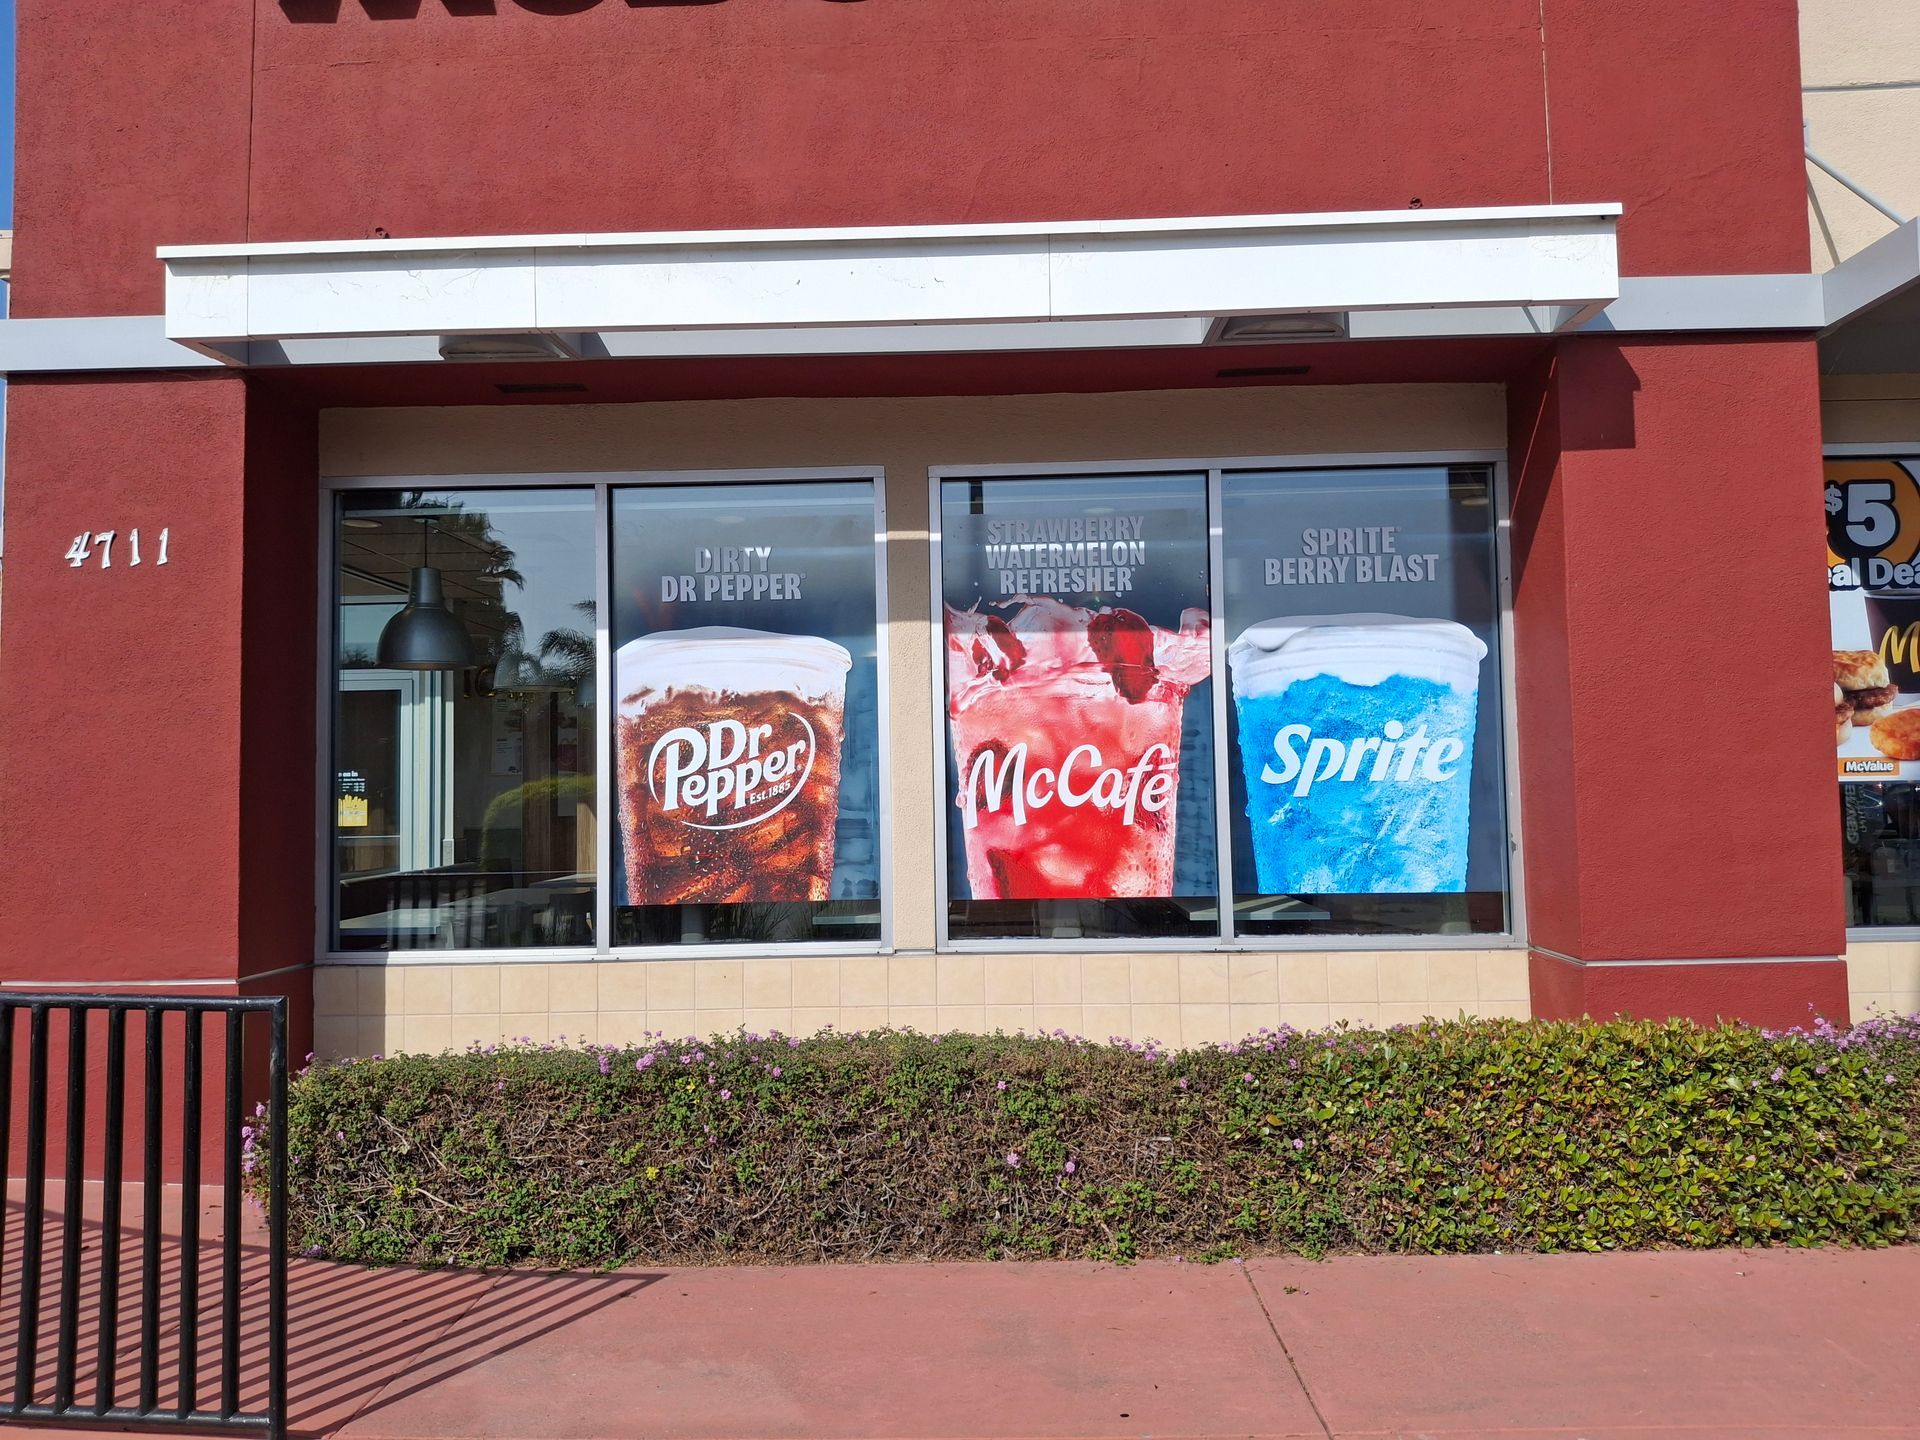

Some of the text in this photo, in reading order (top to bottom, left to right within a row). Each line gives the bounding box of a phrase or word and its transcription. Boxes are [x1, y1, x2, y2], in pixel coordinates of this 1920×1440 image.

[986, 516, 1145, 545] STRAWBERRY
[1824, 484, 1896, 547] $5
[65, 528, 169, 569] 4711
[985, 541, 1146, 569] WATERMELON
[1302, 526, 1397, 556] SPRITE
[695, 546, 772, 573] DIRTY
[1264, 554, 1440, 585] BERRY BLAST
[1828, 557, 1861, 587] al
[661, 573, 802, 603] DR PEPPER
[1000, 567, 1133, 595] REFRESHER
[707, 719, 773, 770] Dr
[1260, 719, 1465, 797] Sprite
[648, 727, 807, 817] Pepper
[1845, 760, 1895, 773] McValue
[966, 742, 1177, 830] McCafé
